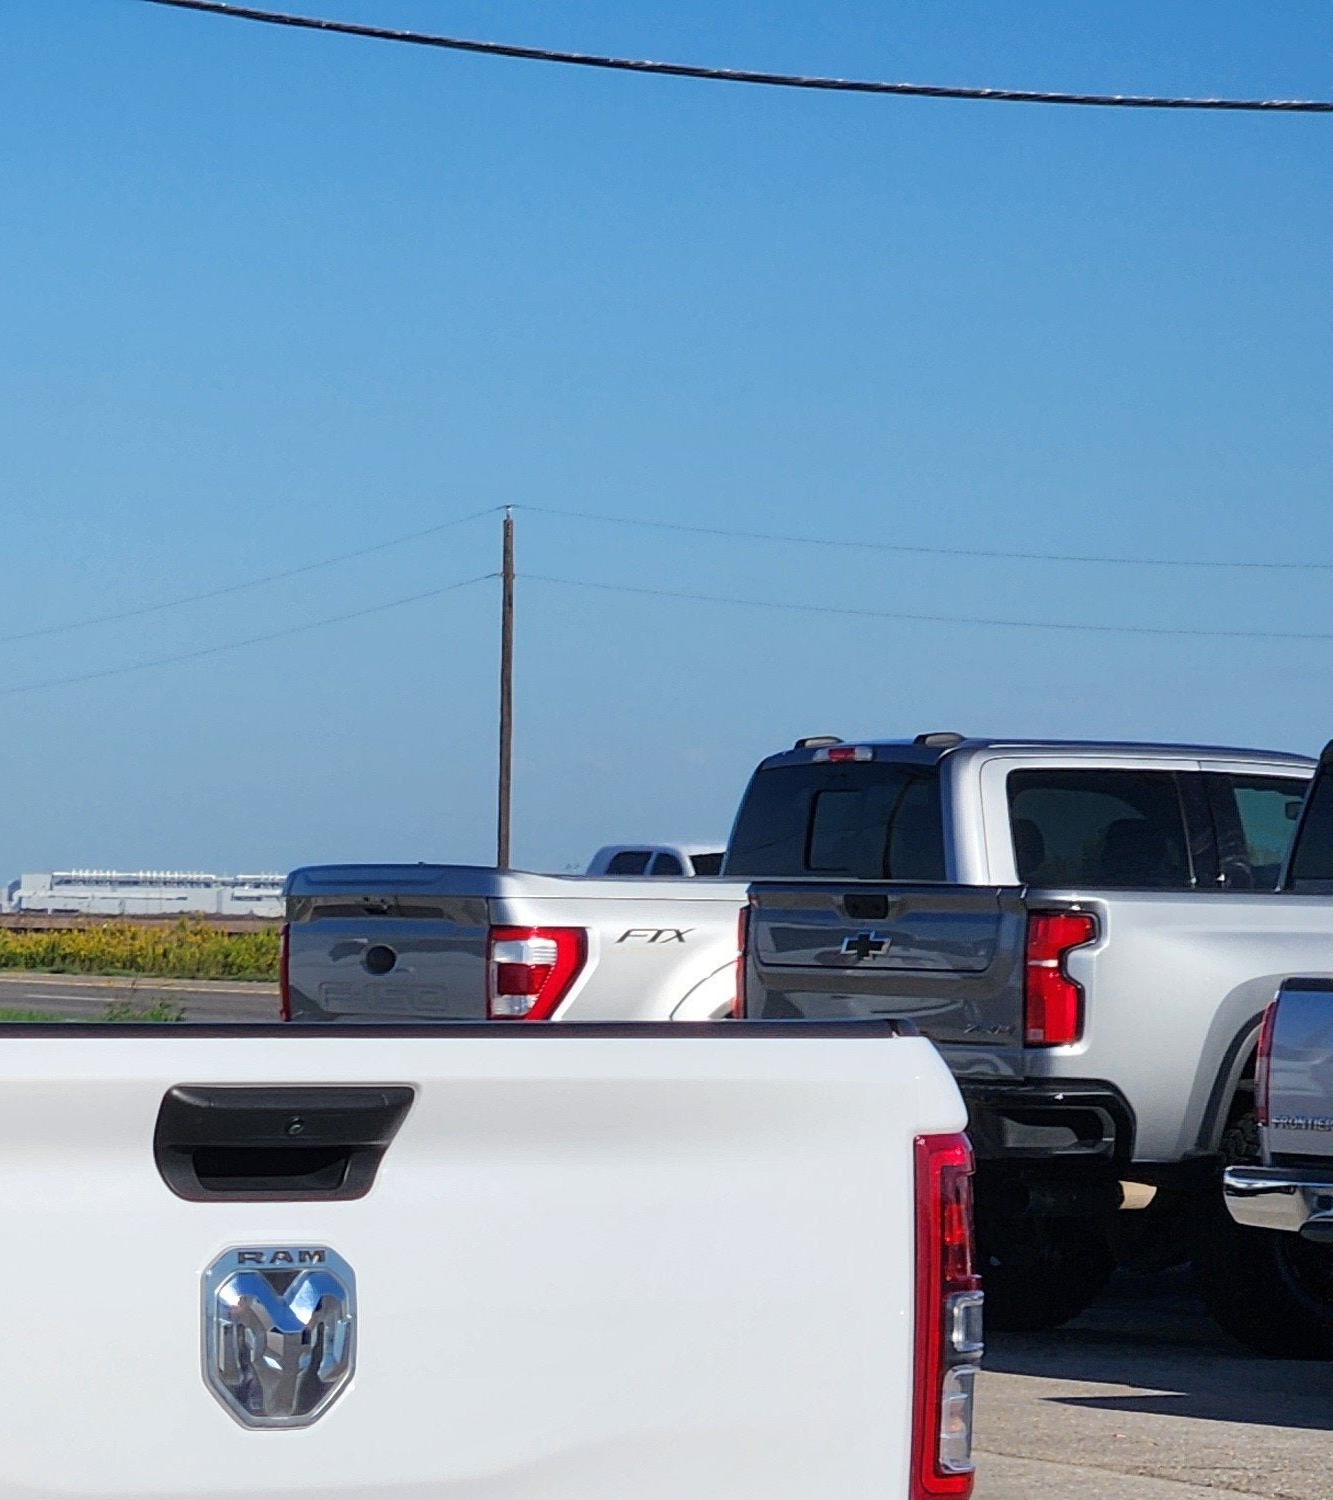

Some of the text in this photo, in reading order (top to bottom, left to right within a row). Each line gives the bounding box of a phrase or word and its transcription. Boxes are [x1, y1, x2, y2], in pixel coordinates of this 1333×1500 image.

[614, 927, 695, 944] FTX
[1272, 1115, 1333, 1132] FRONTIE
[237, 1249, 327, 1265] RAM
